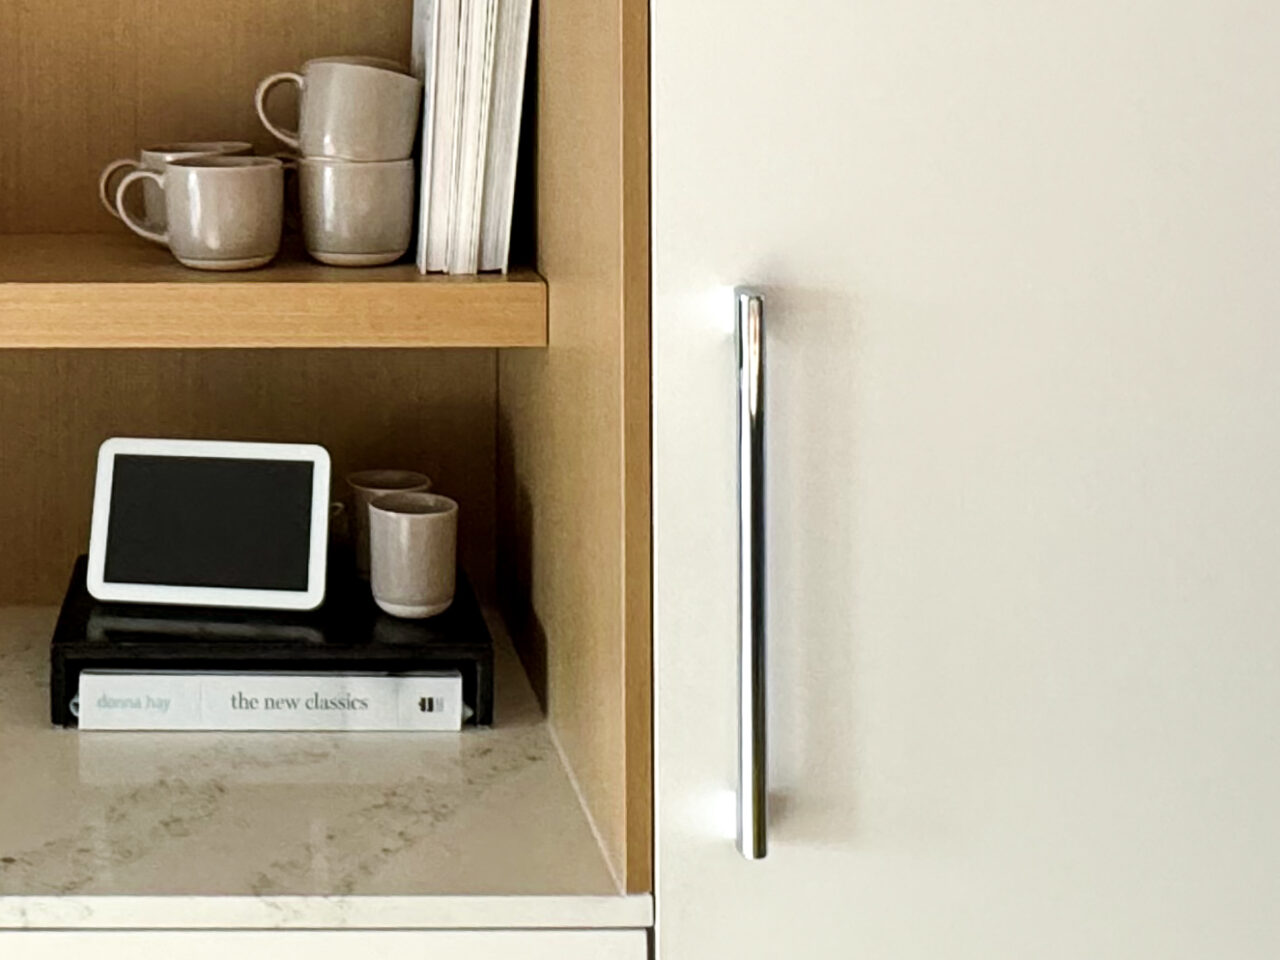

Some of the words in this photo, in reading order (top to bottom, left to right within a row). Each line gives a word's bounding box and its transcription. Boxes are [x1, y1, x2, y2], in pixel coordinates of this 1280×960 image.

[96, 691, 142, 709] donna
[145, 694, 171, 713] hay
[230, 691, 259, 710] the
[264, 697, 300, 710] new
[305, 692, 369, 711] classics
